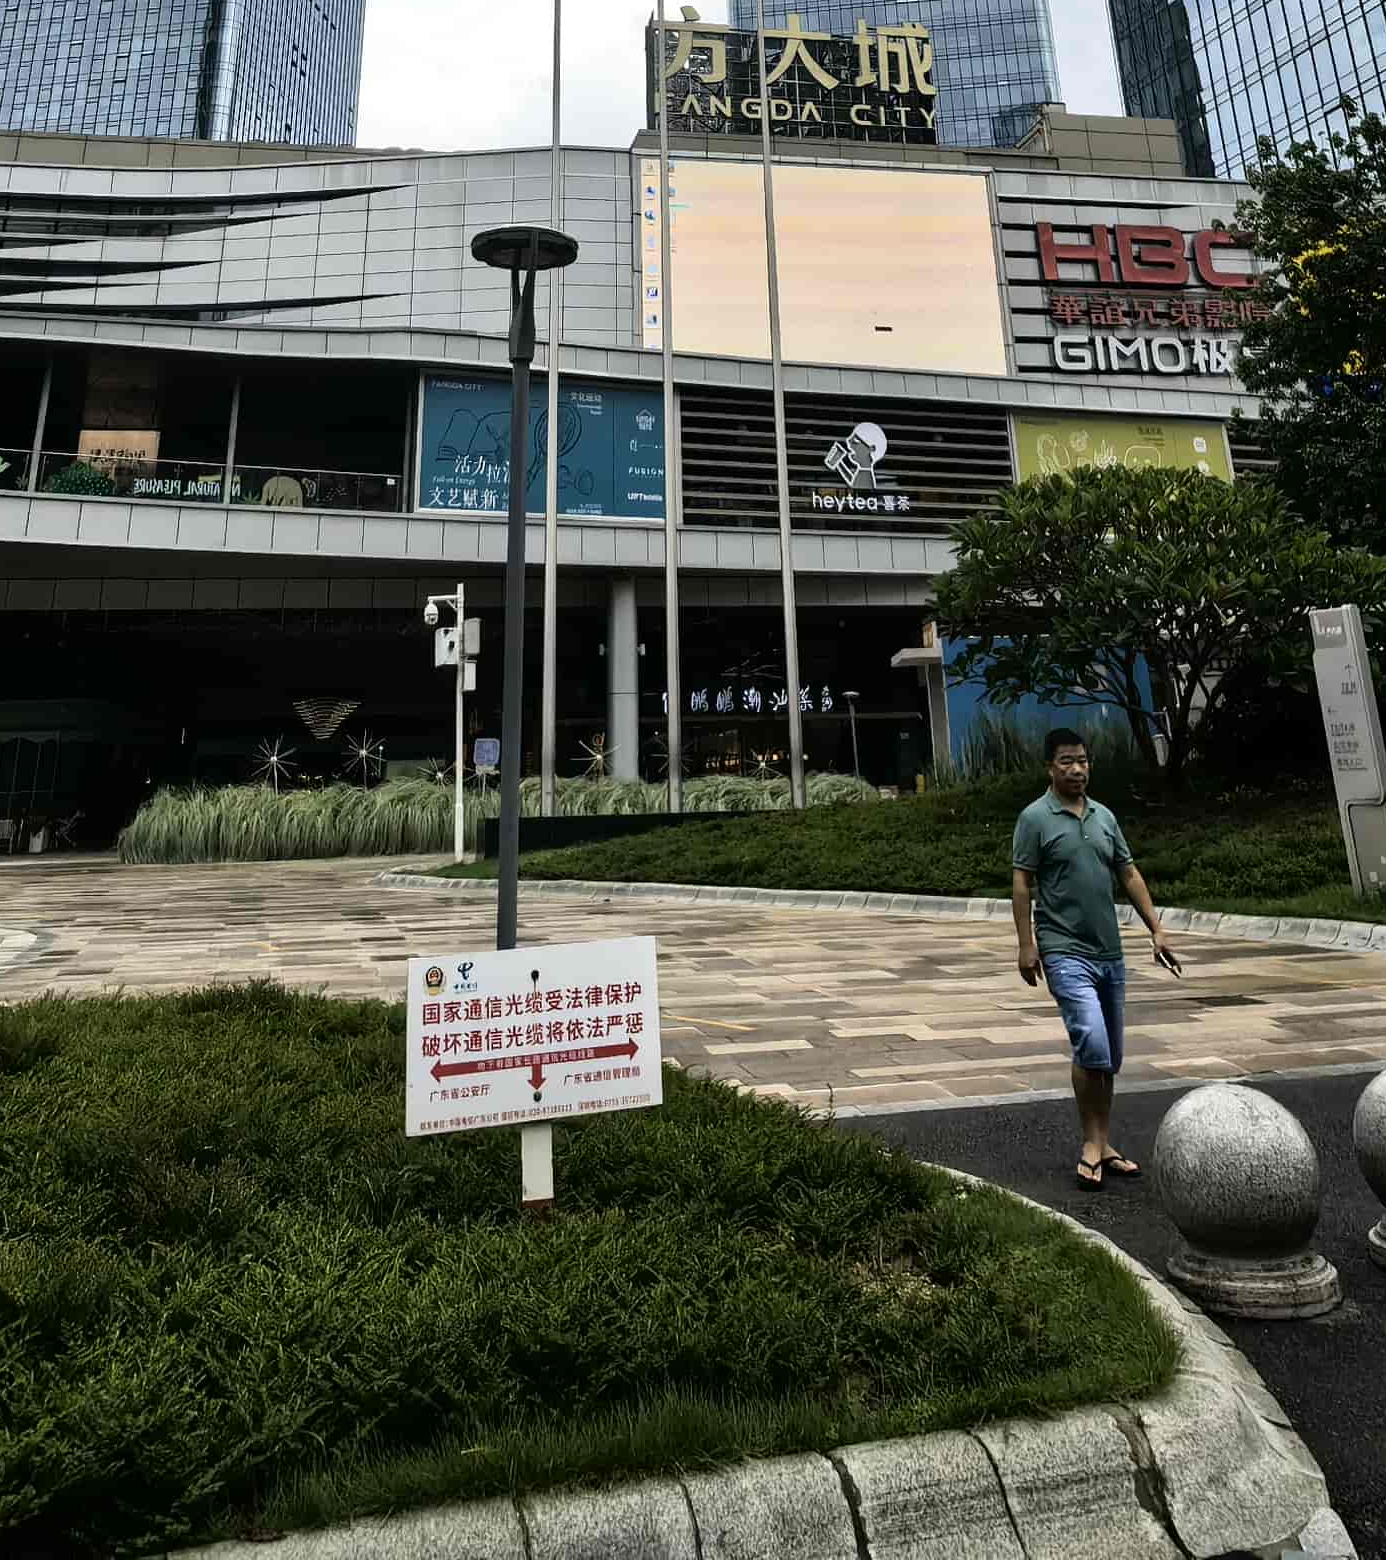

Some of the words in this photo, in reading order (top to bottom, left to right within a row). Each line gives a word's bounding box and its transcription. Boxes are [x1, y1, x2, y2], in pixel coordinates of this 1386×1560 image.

[662, 6, 937, 96] 方大城
[850, 104, 936, 128] CITY
[1036, 222, 1260, 290] HBC
[1053, 334, 1187, 373] GIMO
[812, 491, 878, 513] heytea
[422, 981, 643, 1026] 国家通信光缆受法律保护
[421, 1012, 644, 1058] 破坏通信光缆将依法严惩
[429, 1084, 491, 1103] 广东省公安厅
